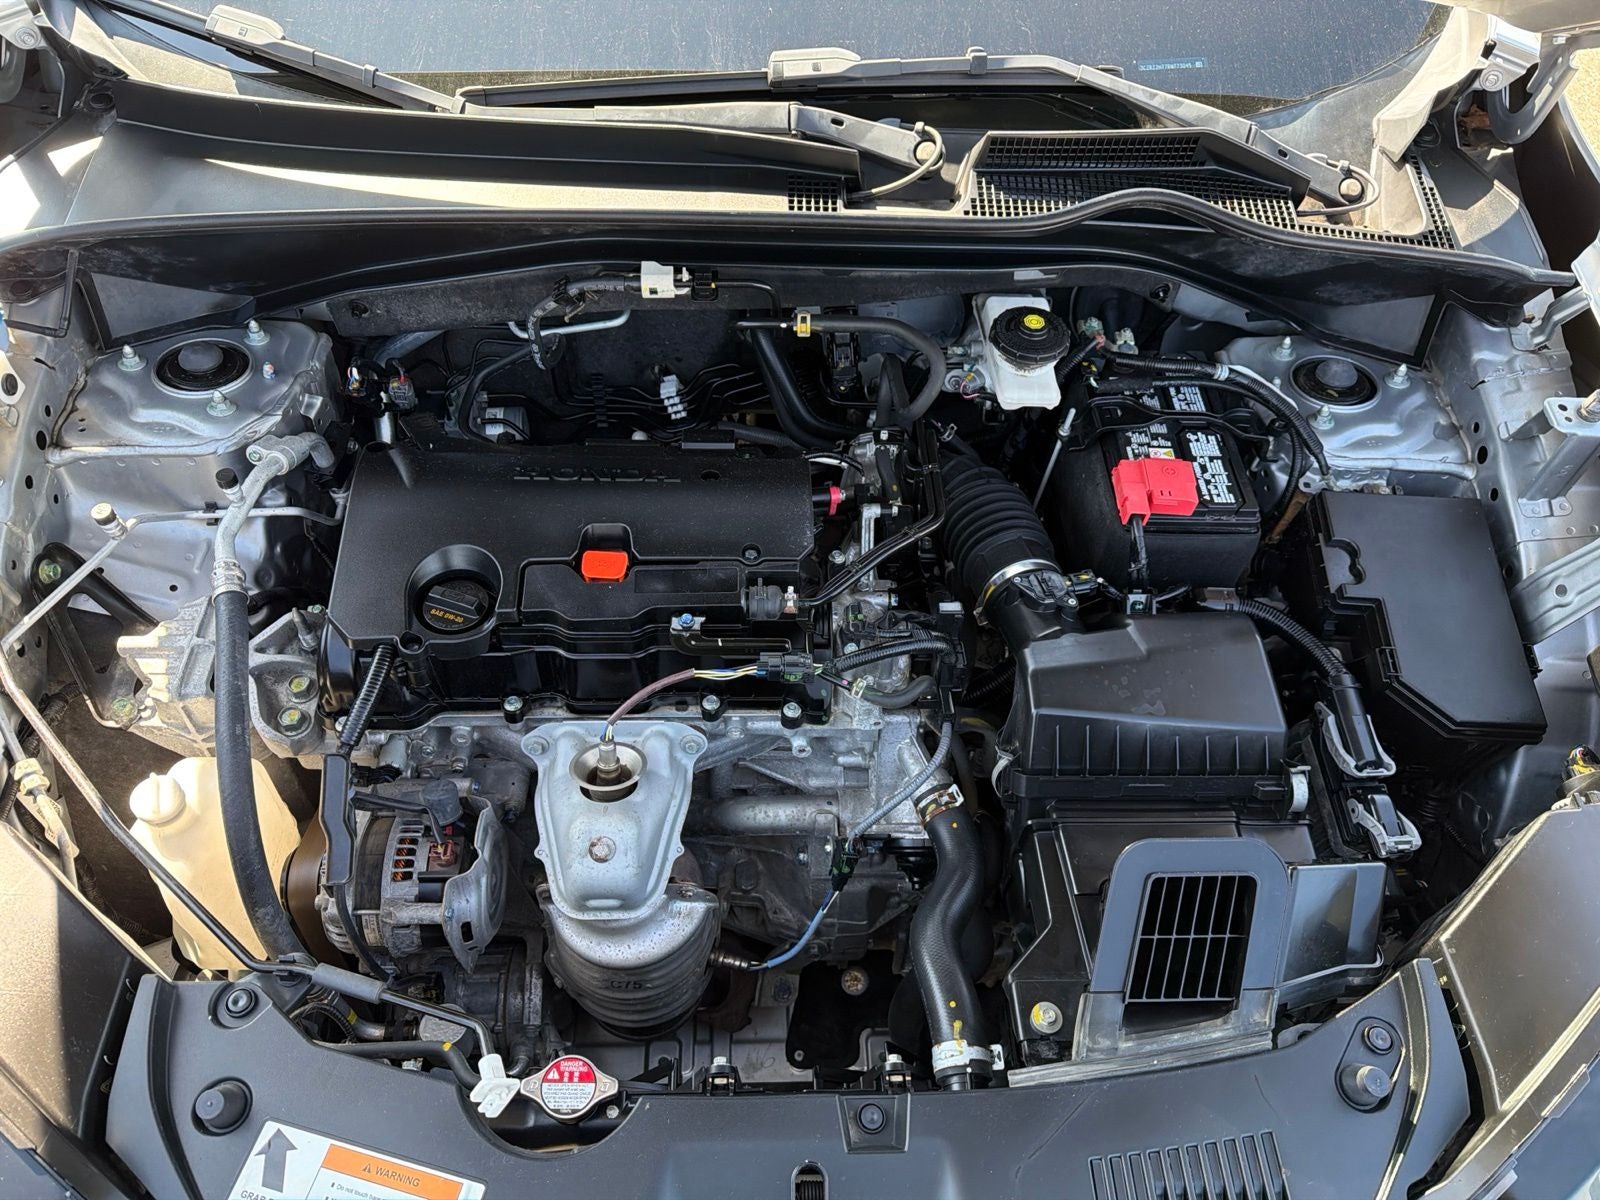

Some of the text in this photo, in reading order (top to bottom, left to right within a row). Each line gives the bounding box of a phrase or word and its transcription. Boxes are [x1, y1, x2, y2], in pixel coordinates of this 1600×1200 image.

[430, 608, 444, 616] SAE
[375, 1166, 421, 1187] WARNING
[335, 1183, 344, 1191] Do
